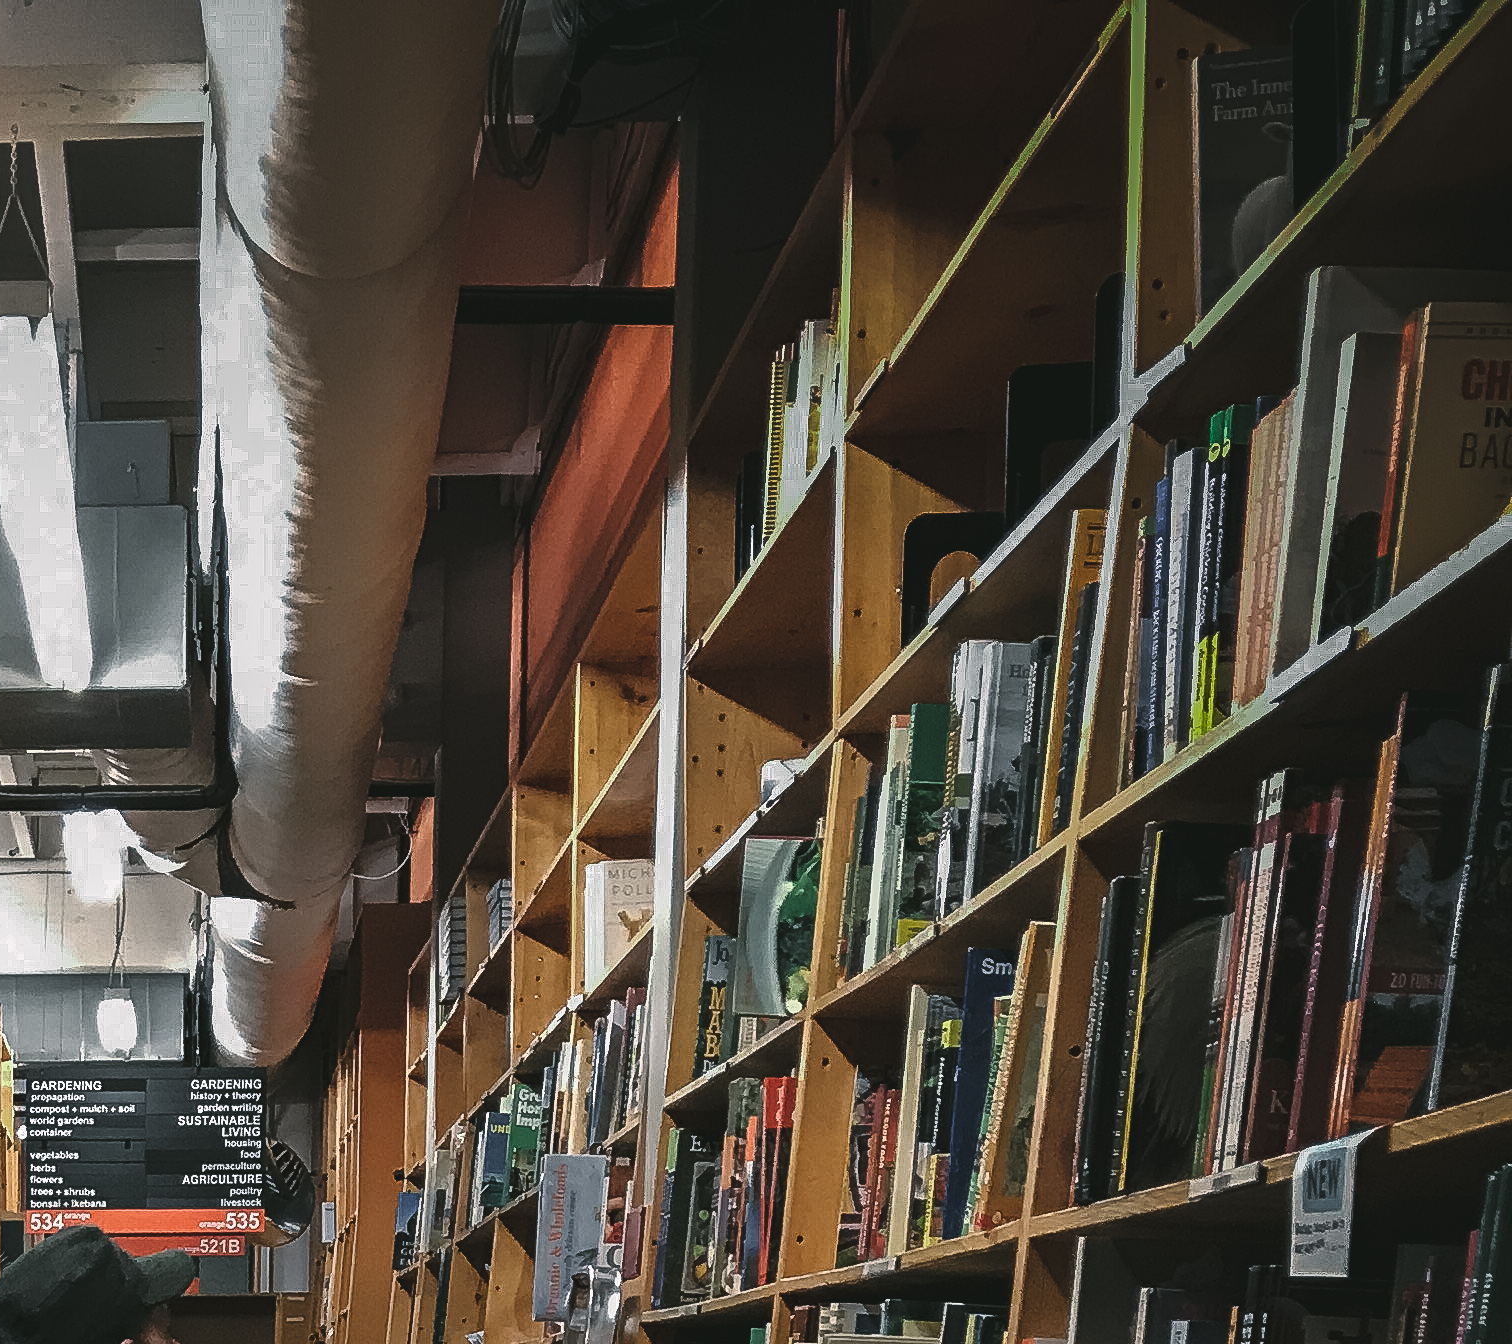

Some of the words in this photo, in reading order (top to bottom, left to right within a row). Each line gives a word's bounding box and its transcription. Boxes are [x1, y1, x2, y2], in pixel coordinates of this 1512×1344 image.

[1212, 82, 1246, 99] The
[1252, 79, 1293, 96] Inne
[1213, 104, 1257, 122] Farm
[31, 1081, 102, 1091] GARDENING
[191, 1079, 261, 1090] GARDENING
[31, 1093, 85, 1102] propagation
[191, 1091, 222, 1101] history
[232, 1091, 261, 1101] theory
[30, 1104, 69, 1114] compost
[80, 1104, 108, 1113] mulch
[119, 1104, 135, 1113] soil
[197, 1104, 229, 1113] garden
[232, 1104, 262, 1113] writing
[30, 1116, 55, 1124] world
[57, 1116, 94, 1126] gardens
[178, 1116, 260, 1126] SUSTAINABLE
[30, 1128, 72, 1136] container
[222, 1127, 261, 1137] LIVING
[225, 1139, 261, 1148] housing
[30, 1151, 79, 1161] vegetables
[240, 1150, 261, 1158] food
[30, 1164, 56, 1172] herbs
[202, 1162, 261, 1172] permaculture
[30, 1175, 63, 1184] flowers
[182, 1174, 262, 1184] AGRICULTURE
[1306, 1158, 1341, 1200] NEW
[30, 1187, 53, 1196] trees
[64, 1187, 95, 1196] shrubs
[230, 1187, 262, 1196] poultry
[30, 1199, 61, 1208] bonsai
[71, 1199, 106, 1208] ikebana
[221, 1199, 261, 1207] livestock
[30, 1213, 64, 1230] 534
[64, 1212, 90, 1221] orange
[226, 1213, 260, 1229] 535
[199, 1240, 240, 1253] 521B
